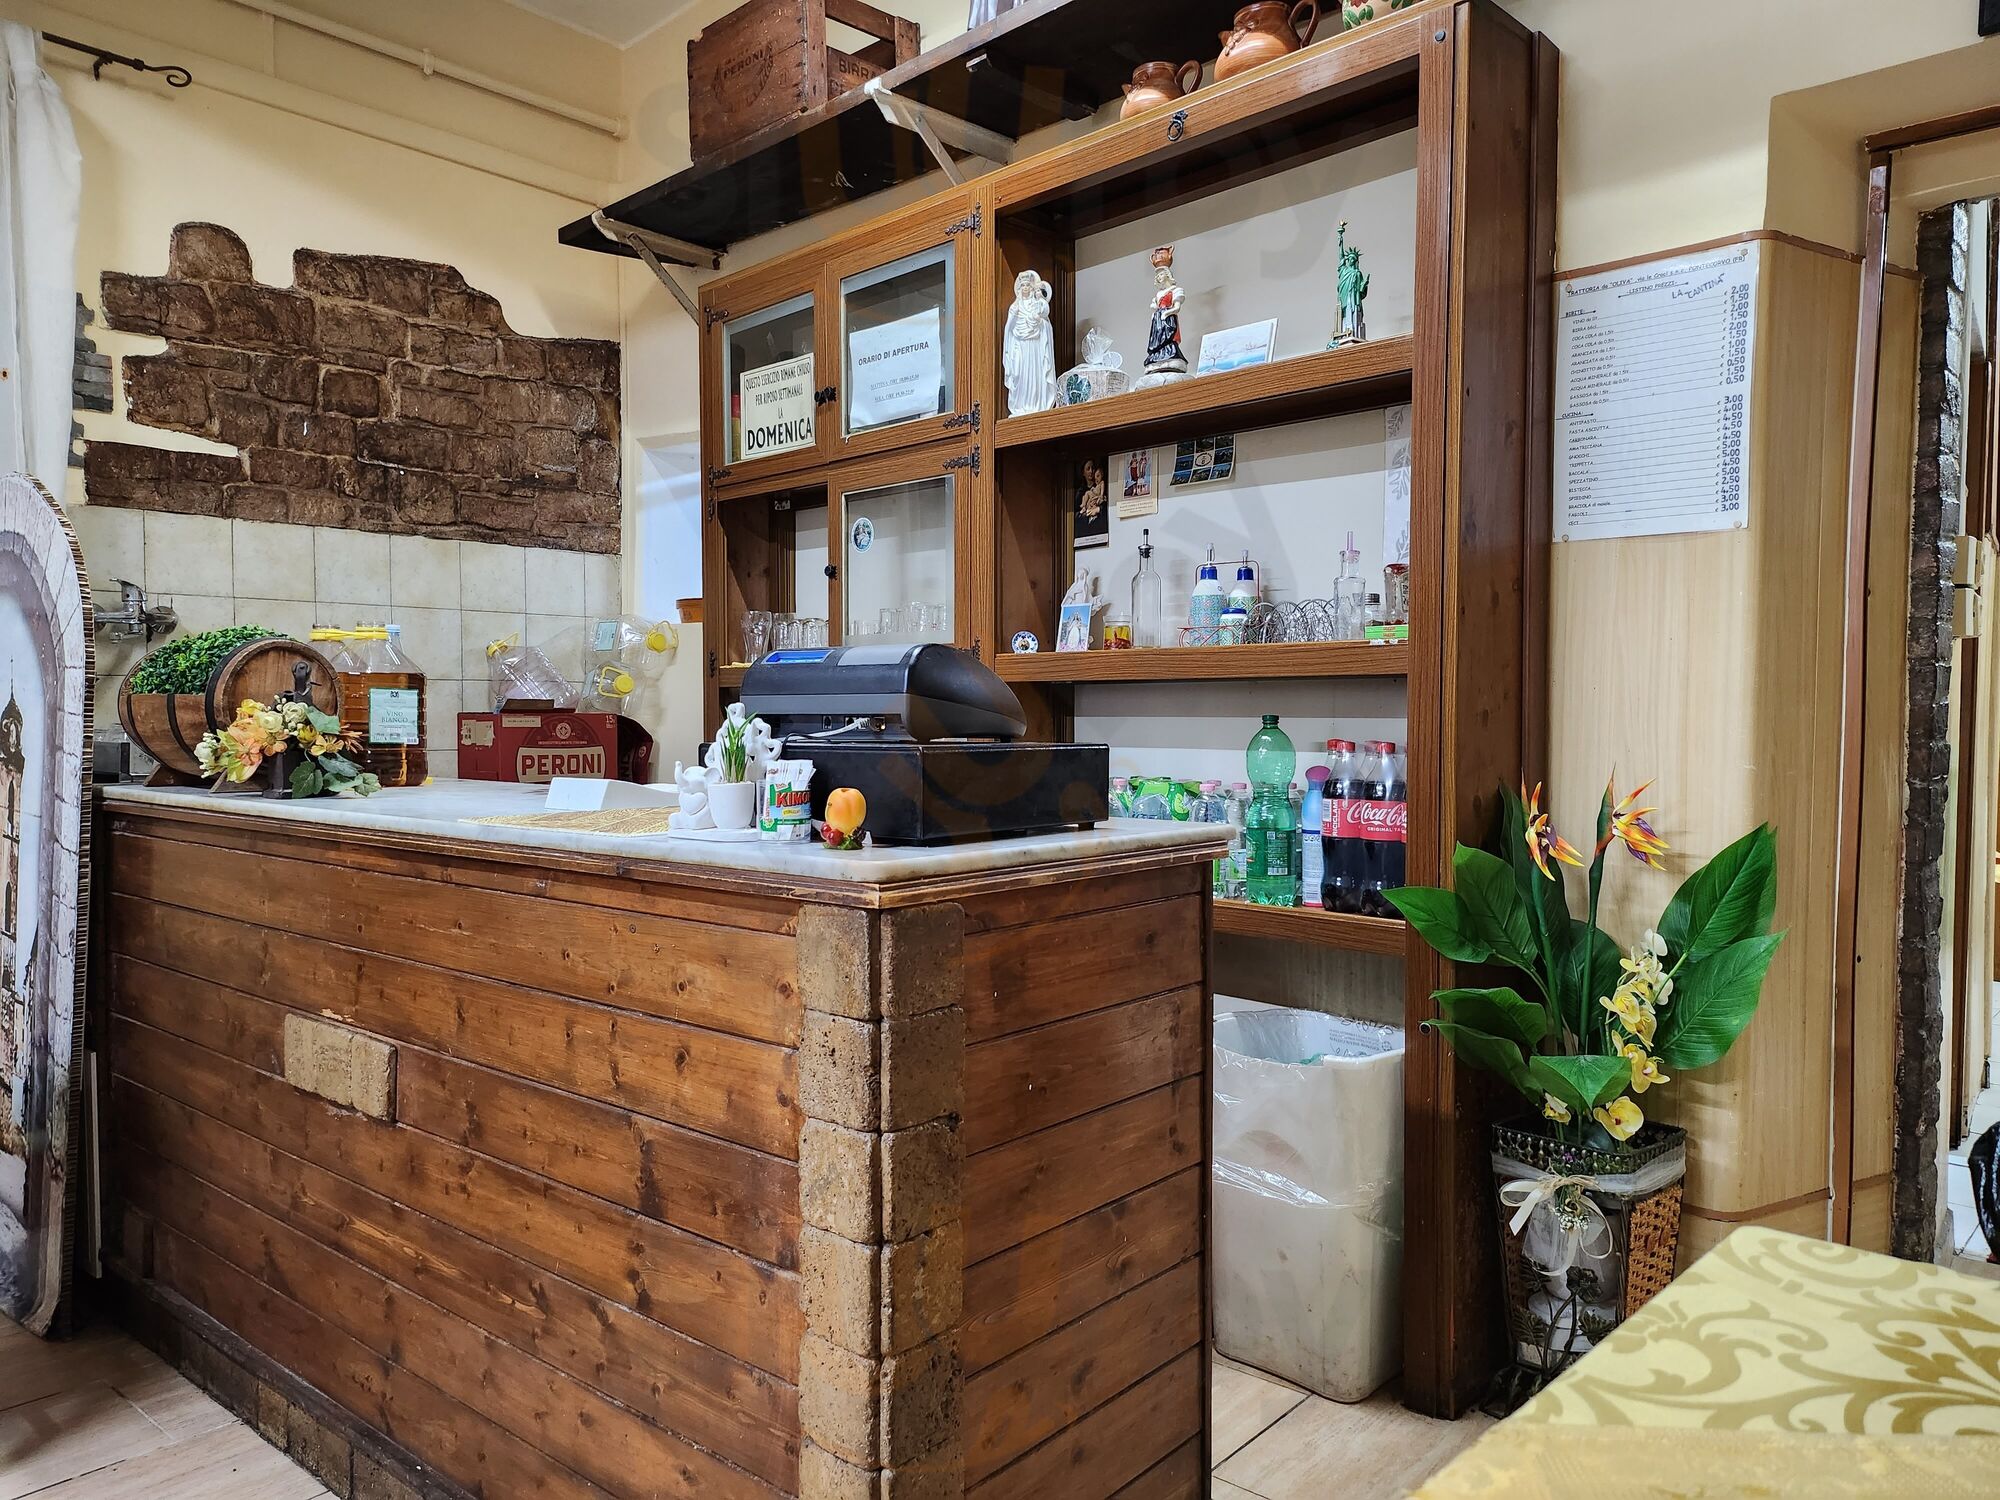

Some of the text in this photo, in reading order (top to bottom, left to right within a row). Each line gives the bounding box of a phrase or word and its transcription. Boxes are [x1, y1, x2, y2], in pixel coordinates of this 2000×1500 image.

[724, 50, 764, 79] PERONI
[1568, 286, 1600, 296] TRATTORIA
[858, 341, 929, 365] ORARIO DI APERTURA
[1571, 350, 1598, 358] ARANCIATA
[1571, 358, 1598, 366] ARANCIATA
[746, 362, 810, 392] QUESTO ESERCIZIO RIMANE CHIUSO
[764, 390, 777, 405] RIPOSO
[778, 383, 803, 401] SETTIMANALE
[778, 407, 783, 419] LA
[748, 417, 812, 450] DOMENICA
[521, 754, 601, 775] PERONI
